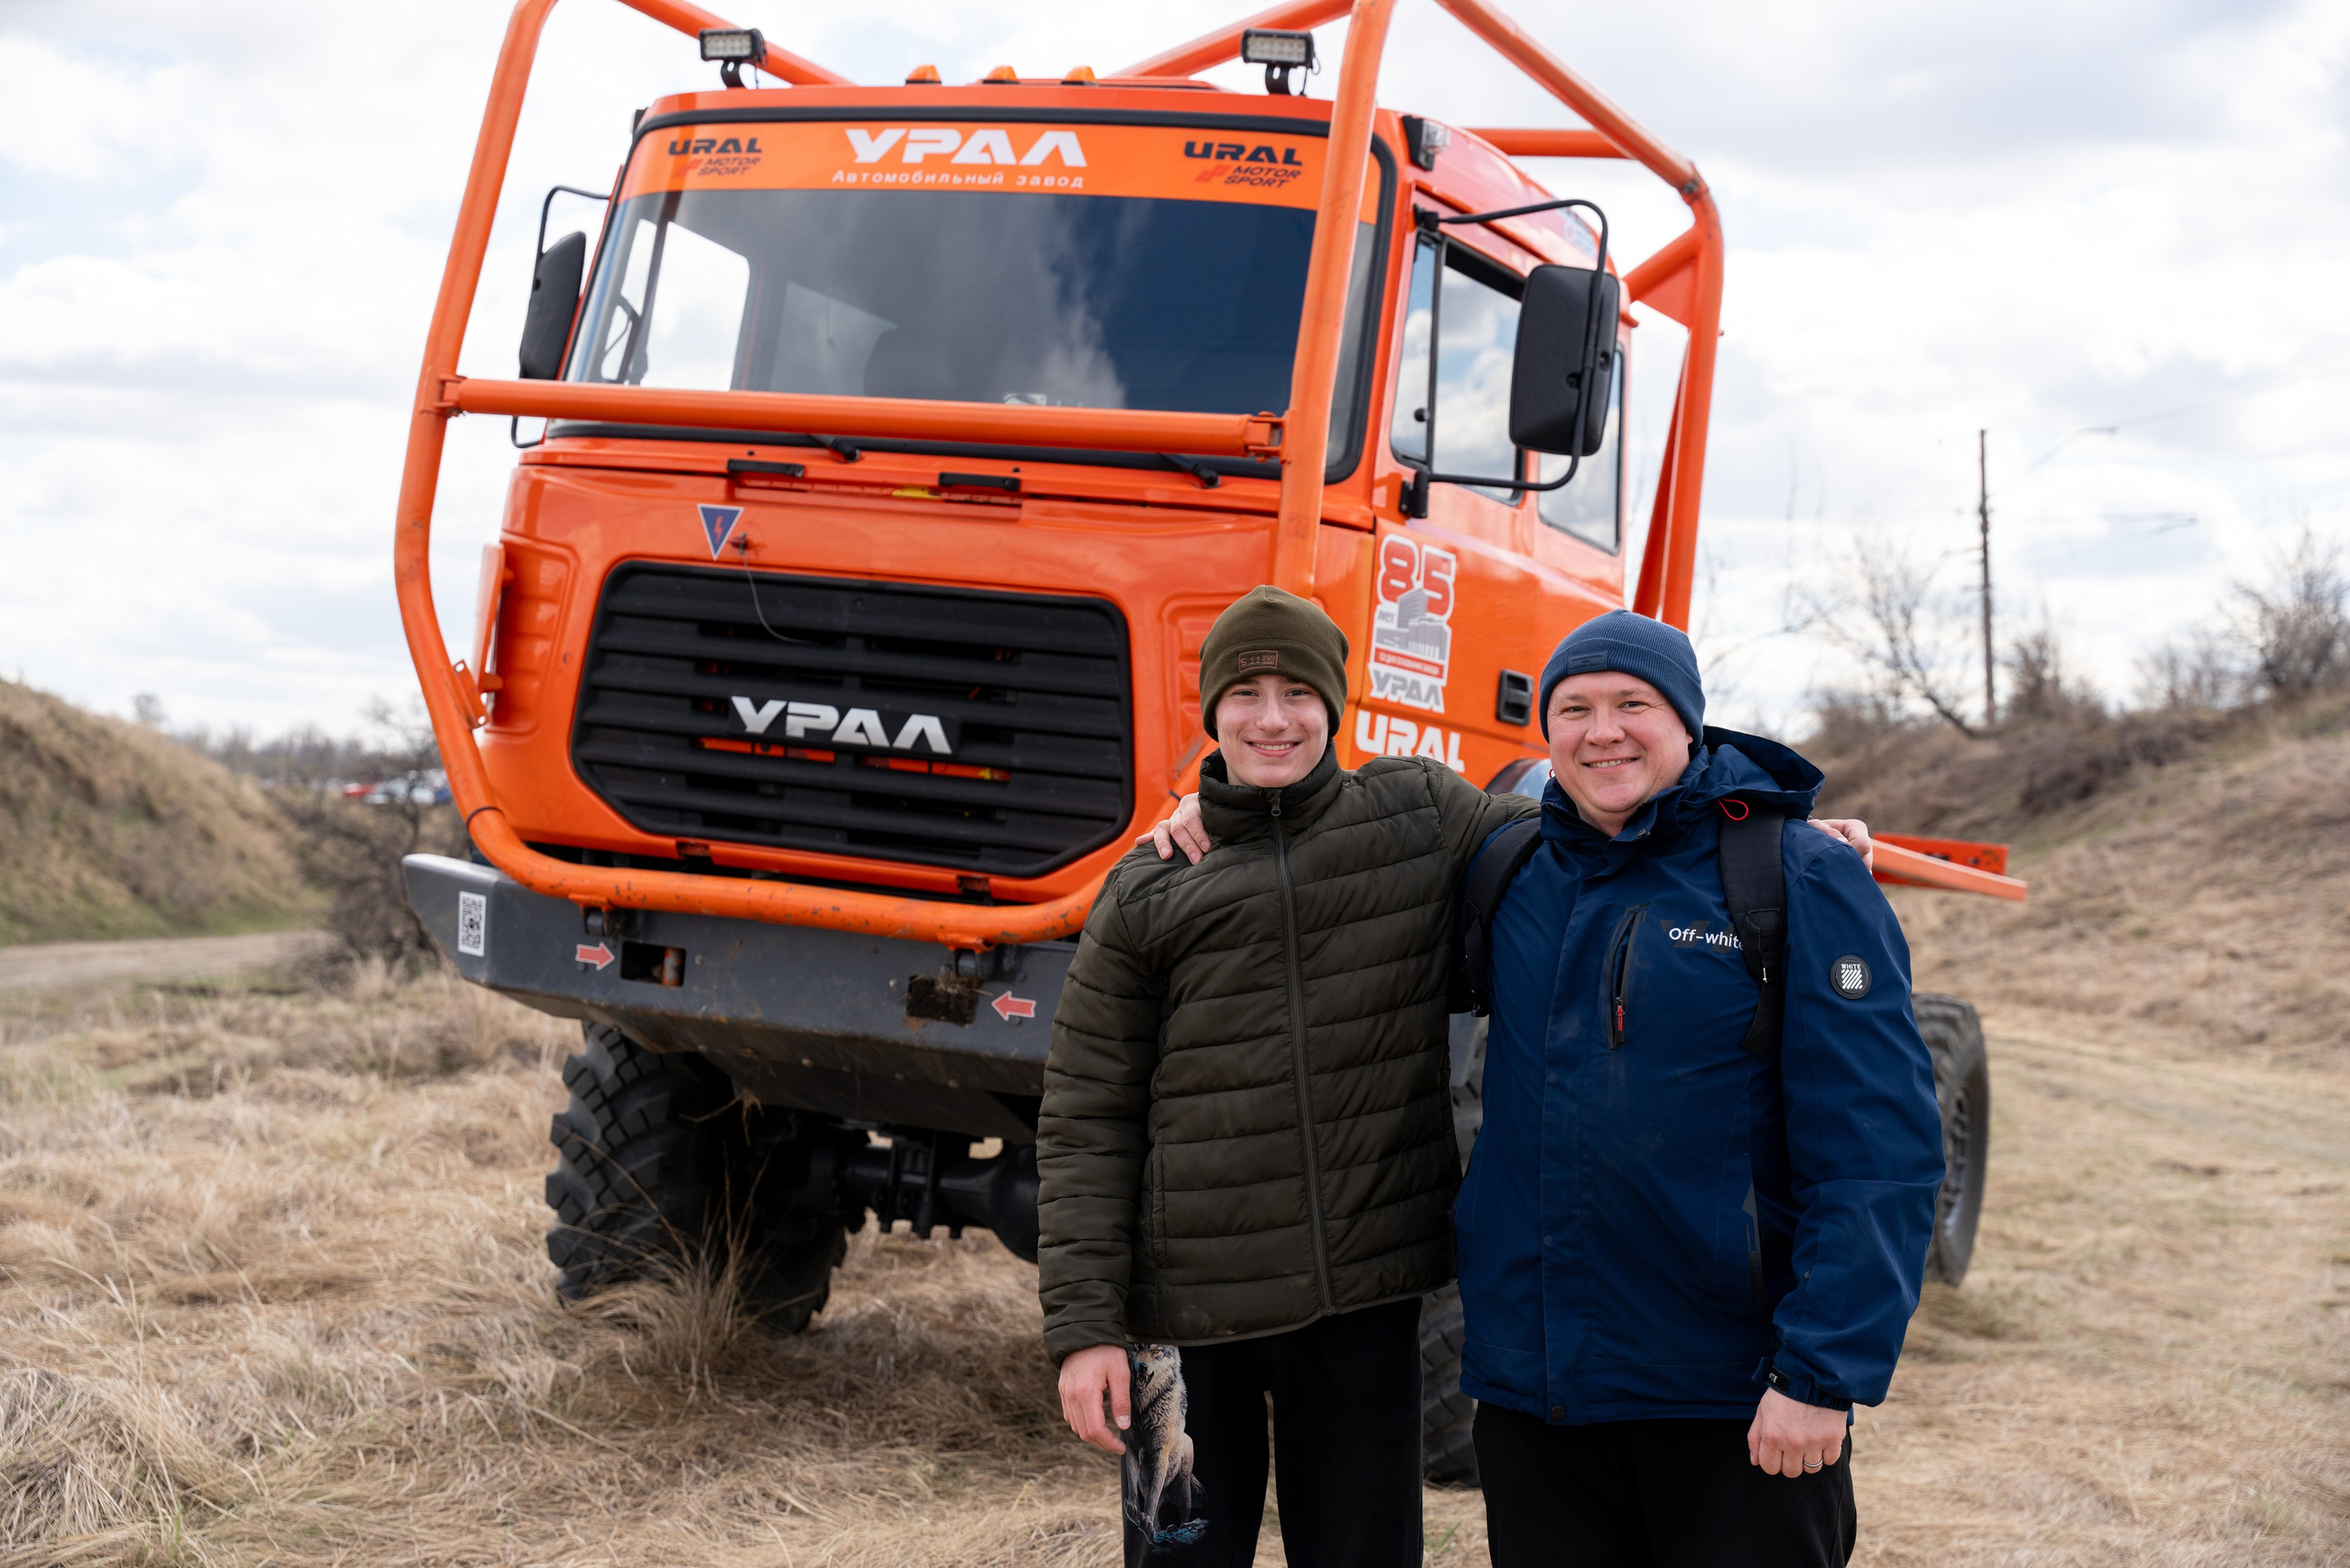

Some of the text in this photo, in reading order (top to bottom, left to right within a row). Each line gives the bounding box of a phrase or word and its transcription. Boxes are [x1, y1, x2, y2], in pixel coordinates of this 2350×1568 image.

[668, 138, 762, 155] URAL
[845, 129, 1088, 167] УРАЛ
[1184, 140, 1303, 166] URAL
[698, 166, 751, 176] SPORT
[706, 157, 761, 167] MOTOR
[1233, 166, 1302, 179] MOTOR
[832, 169, 1084, 189] Автомобильный завод
[1224, 174, 1290, 188] SPORT
[1379, 535, 1455, 620] 85
[1372, 670, 1441, 707] УРАЛ
[731, 695, 953, 755] УРАЛ
[1356, 710, 1465, 773] URAL
